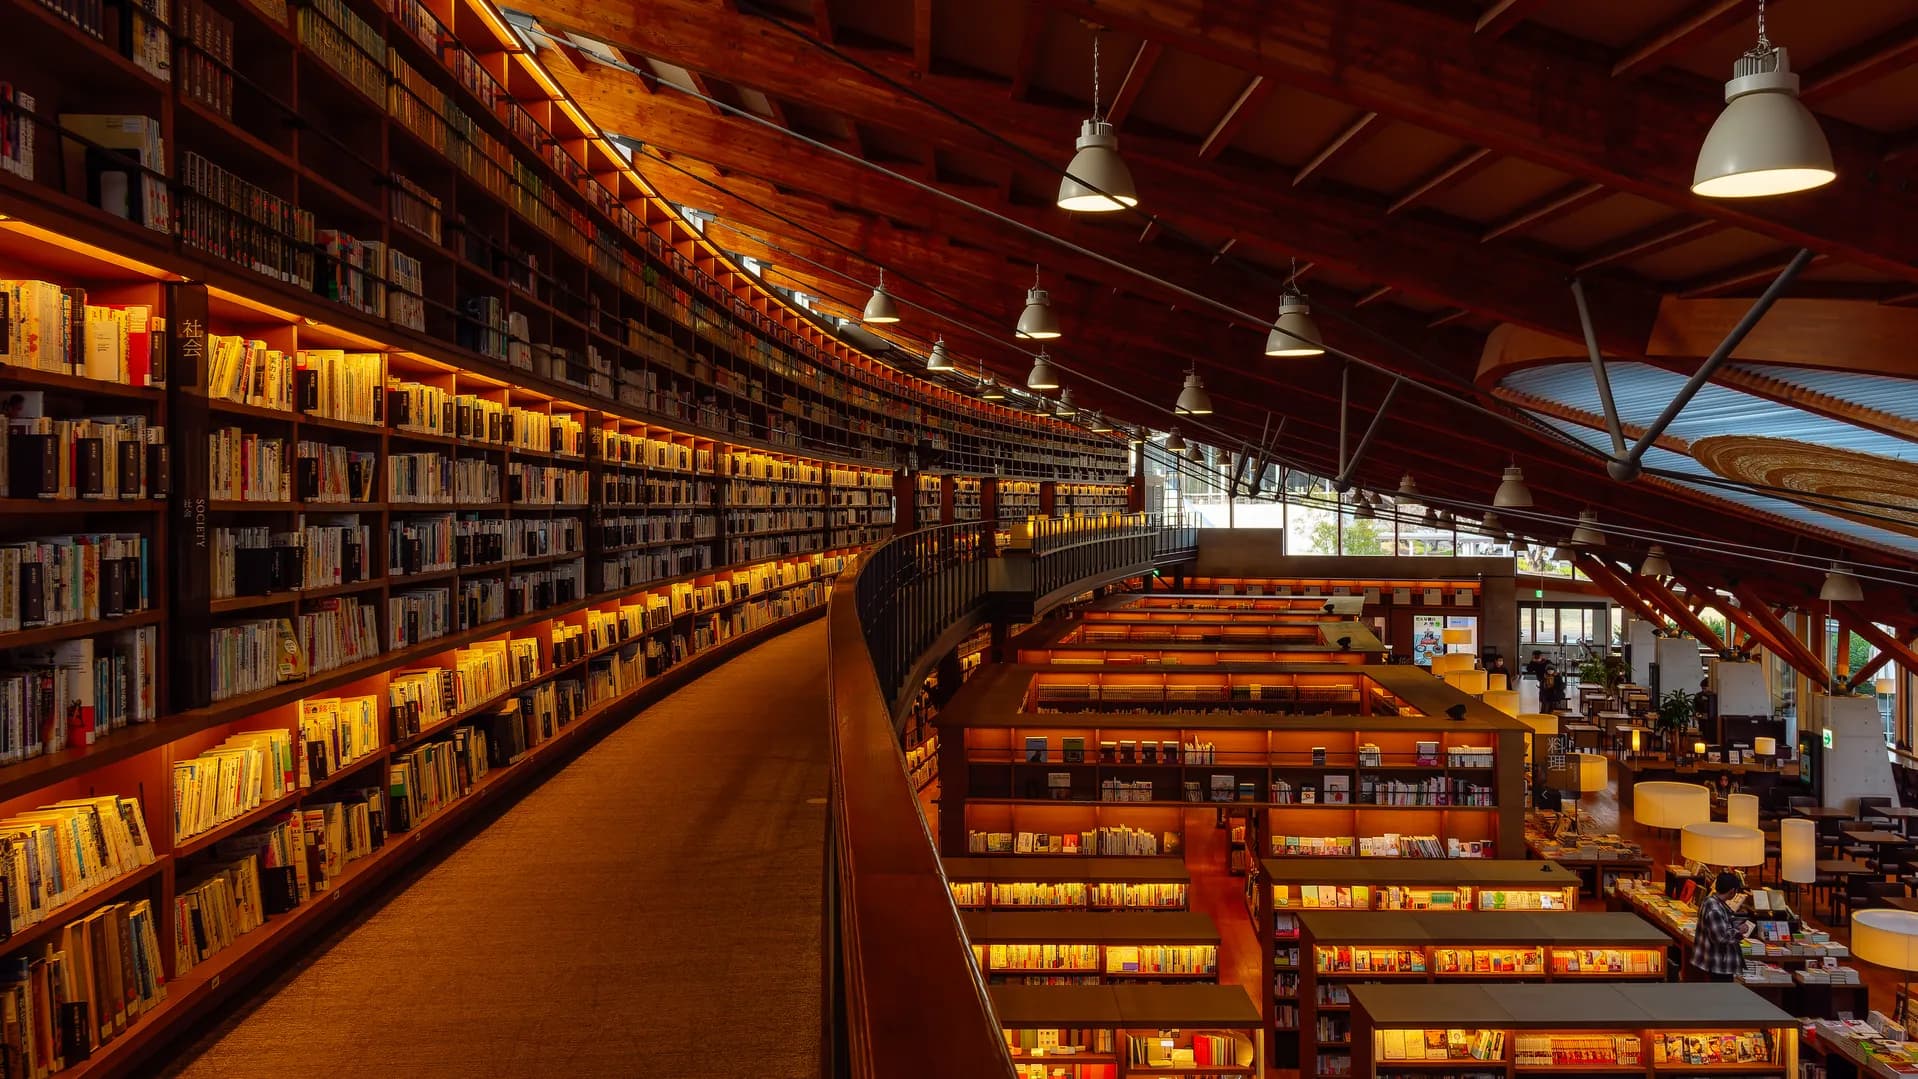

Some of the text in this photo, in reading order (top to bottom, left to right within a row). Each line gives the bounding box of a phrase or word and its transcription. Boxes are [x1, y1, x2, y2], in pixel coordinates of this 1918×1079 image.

[182, 319, 202, 357] 社会
[195, 498, 206, 548] SOCIETY
[1547, 736, 1567, 771] 料理
